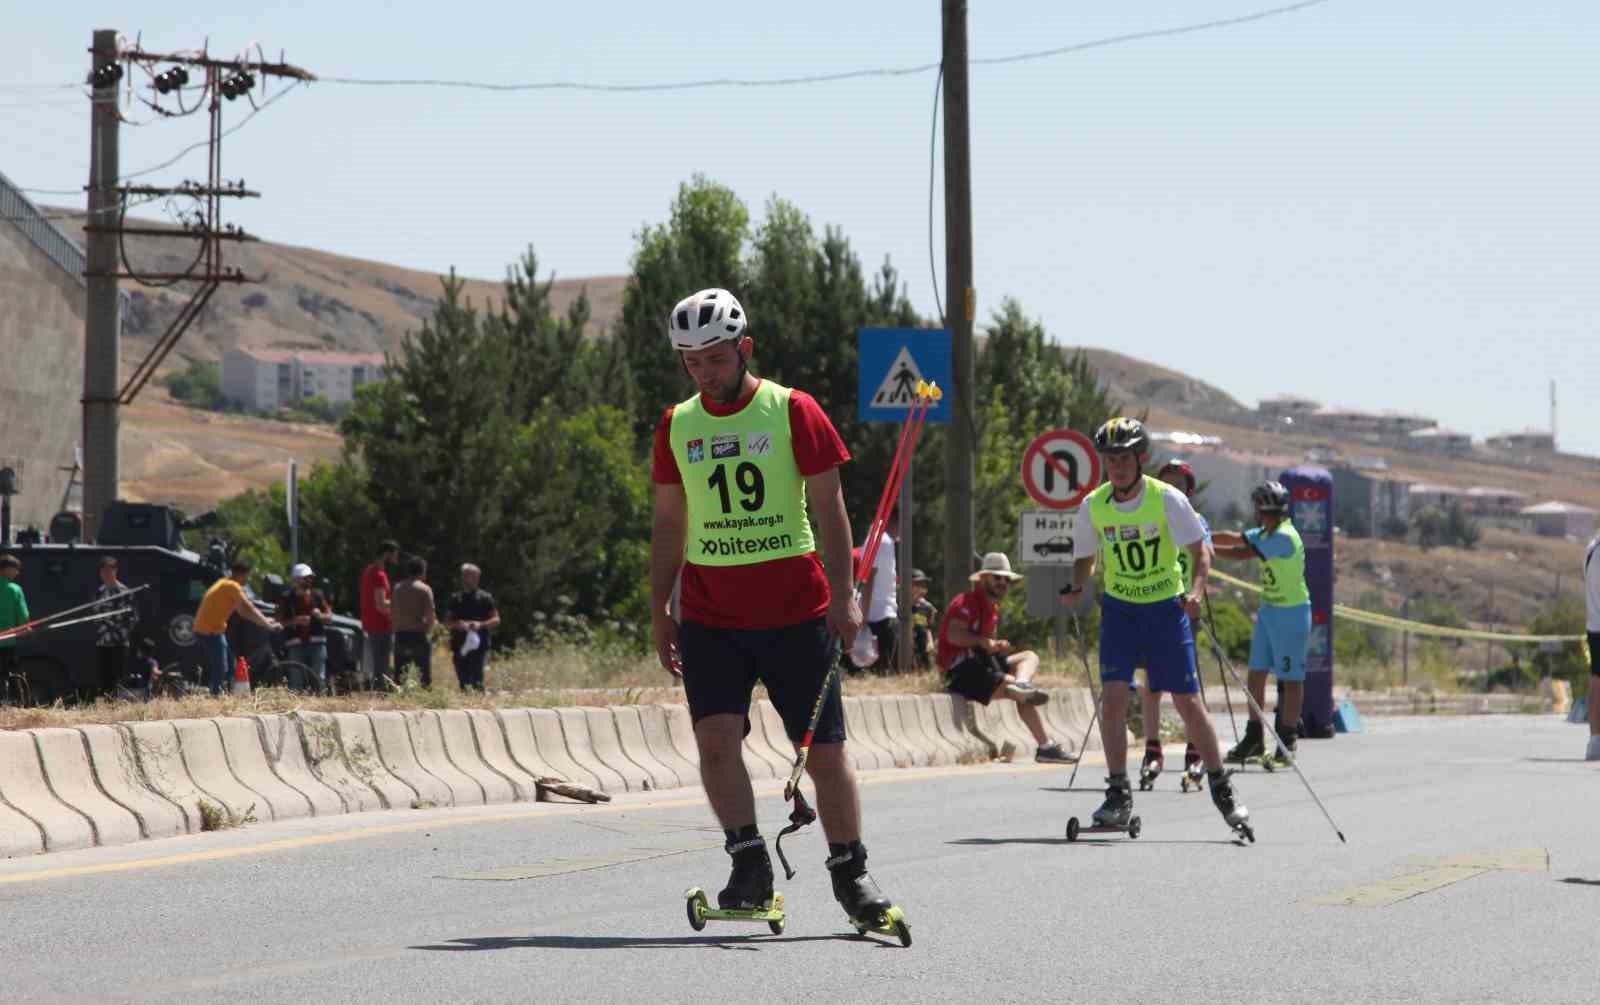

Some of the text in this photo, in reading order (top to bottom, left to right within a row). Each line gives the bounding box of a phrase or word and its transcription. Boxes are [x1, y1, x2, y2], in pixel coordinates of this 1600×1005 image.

[708, 461, 765, 514] 19
[1035, 517, 1074, 529] Hari
[719, 533, 793, 556] bitexen
[1112, 535, 1160, 572] 107
[1282, 655, 1291, 673] 3
